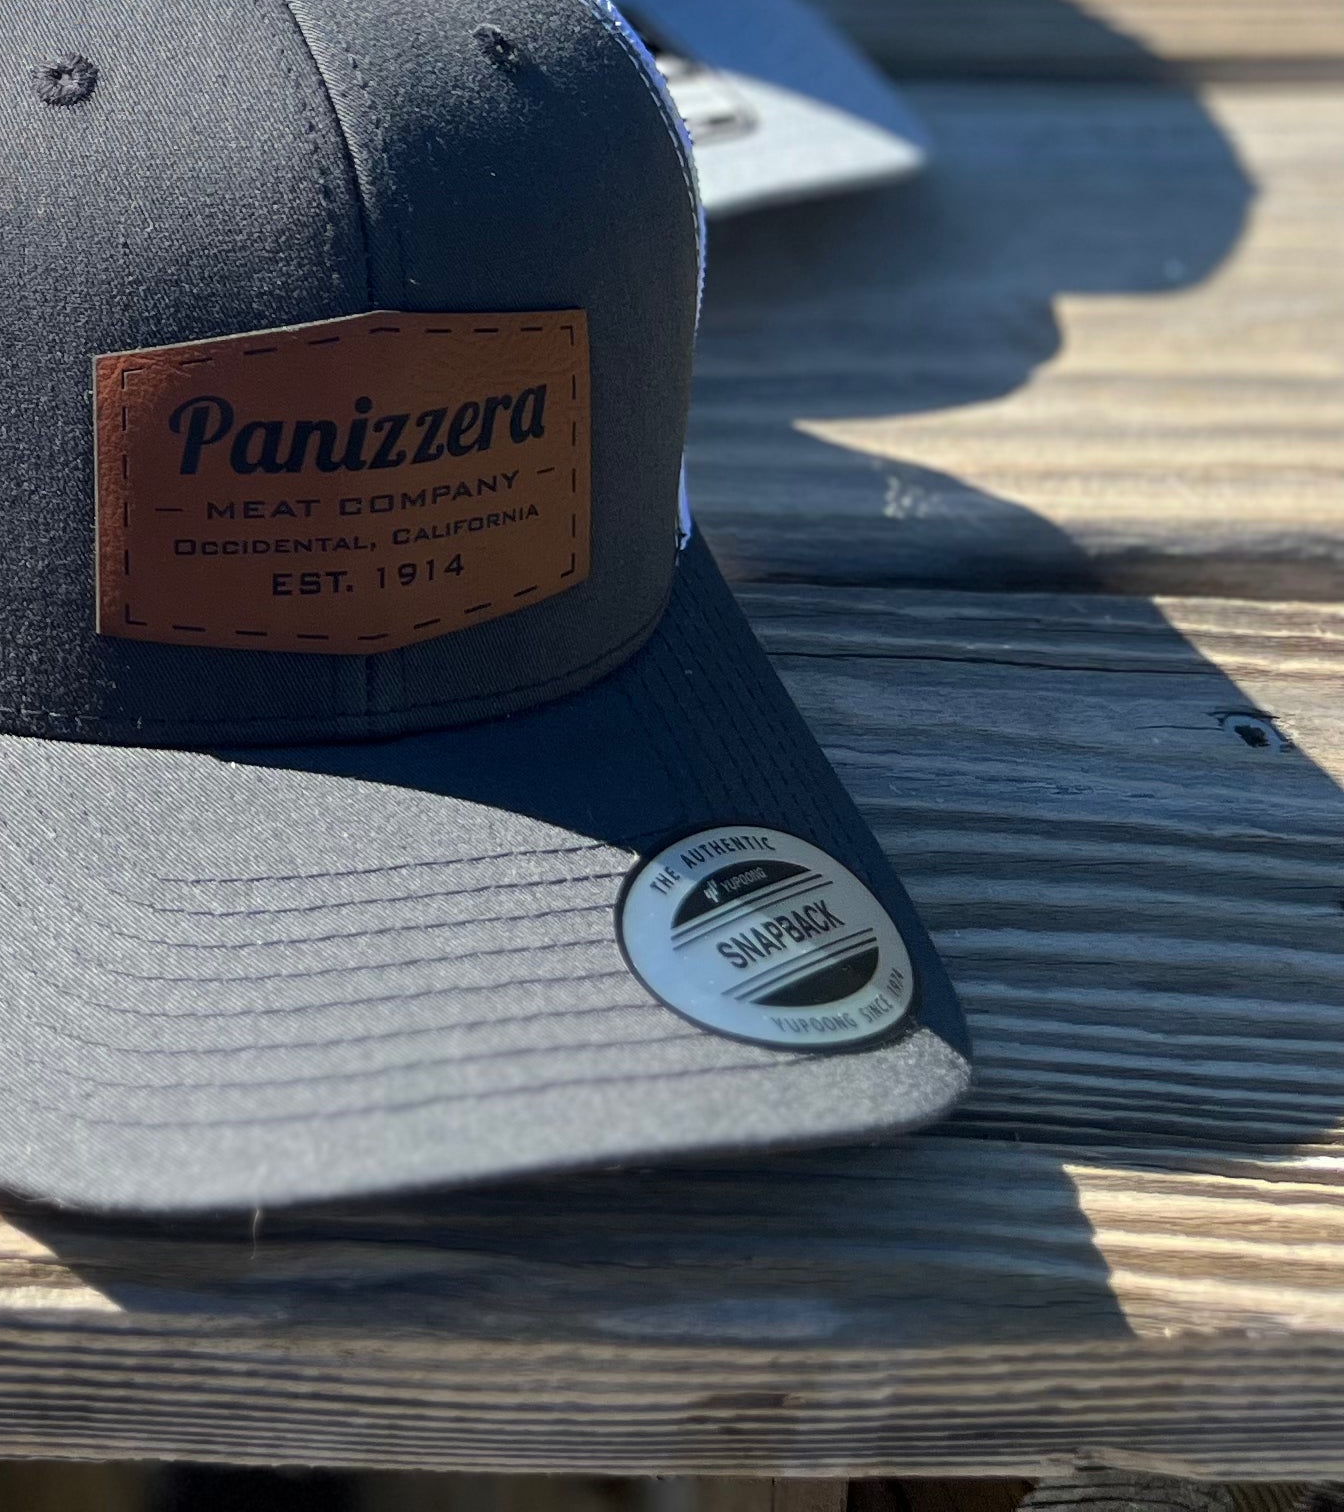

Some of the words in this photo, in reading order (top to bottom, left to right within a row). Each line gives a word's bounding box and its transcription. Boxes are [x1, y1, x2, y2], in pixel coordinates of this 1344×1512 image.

[168, 383, 548, 476] Panizzera
[206, 498, 321, 521] MEAT
[338, 470, 520, 517] COMPANY
[271, 571, 355, 597] EST.
[375, 552, 465, 590] 1914
[650, 866, 681, 895] THE
[679, 835, 776, 869] AUTHENTIC
[715, 899, 846, 969] SNAPBACK
[770, 1012, 858, 1033] YUPOONG
[858, 993, 893, 1024] SINCE
